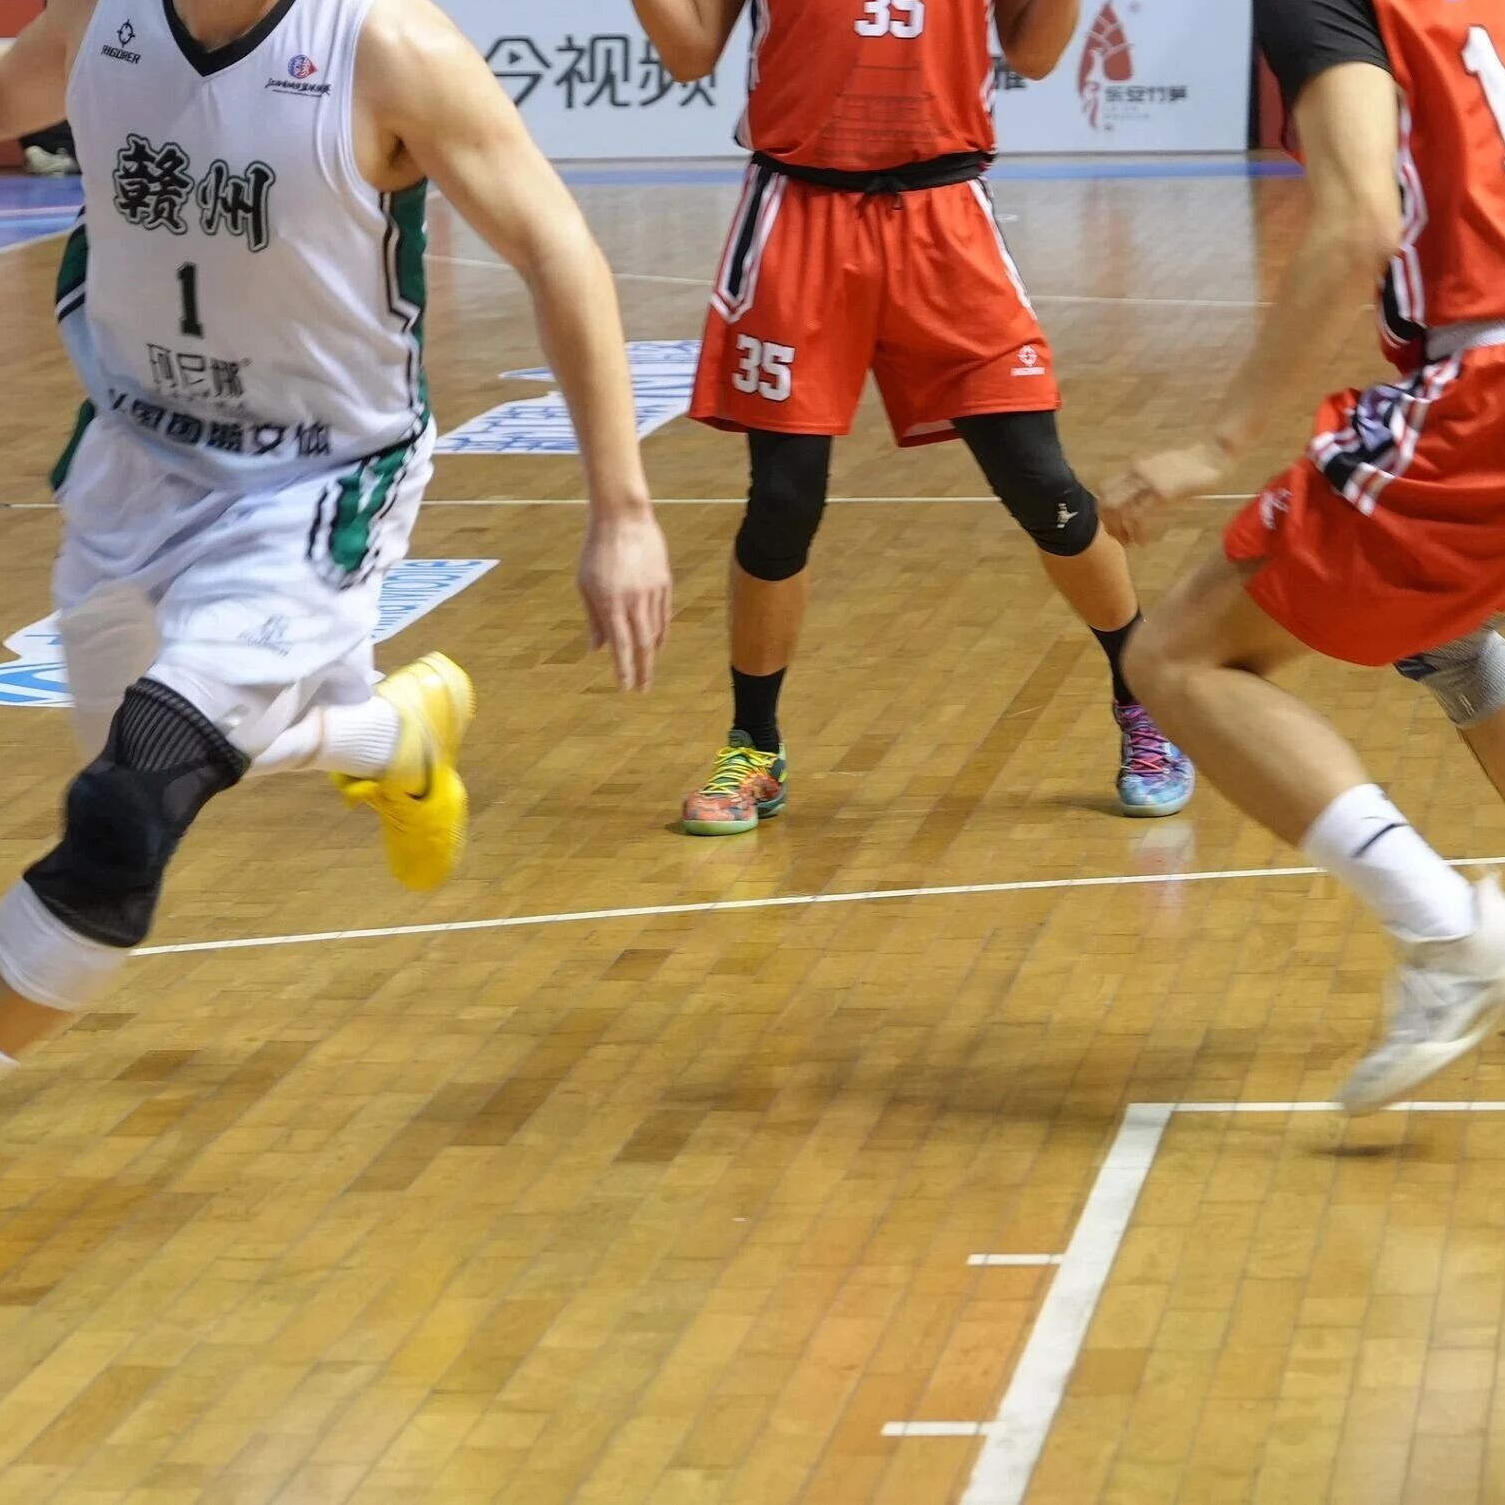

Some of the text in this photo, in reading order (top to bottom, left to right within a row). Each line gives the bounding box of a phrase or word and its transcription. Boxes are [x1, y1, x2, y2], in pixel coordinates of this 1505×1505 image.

[112, 133, 275, 253] 赣州
[176, 261, 205, 339] 1
[731, 333, 796, 402] 35
